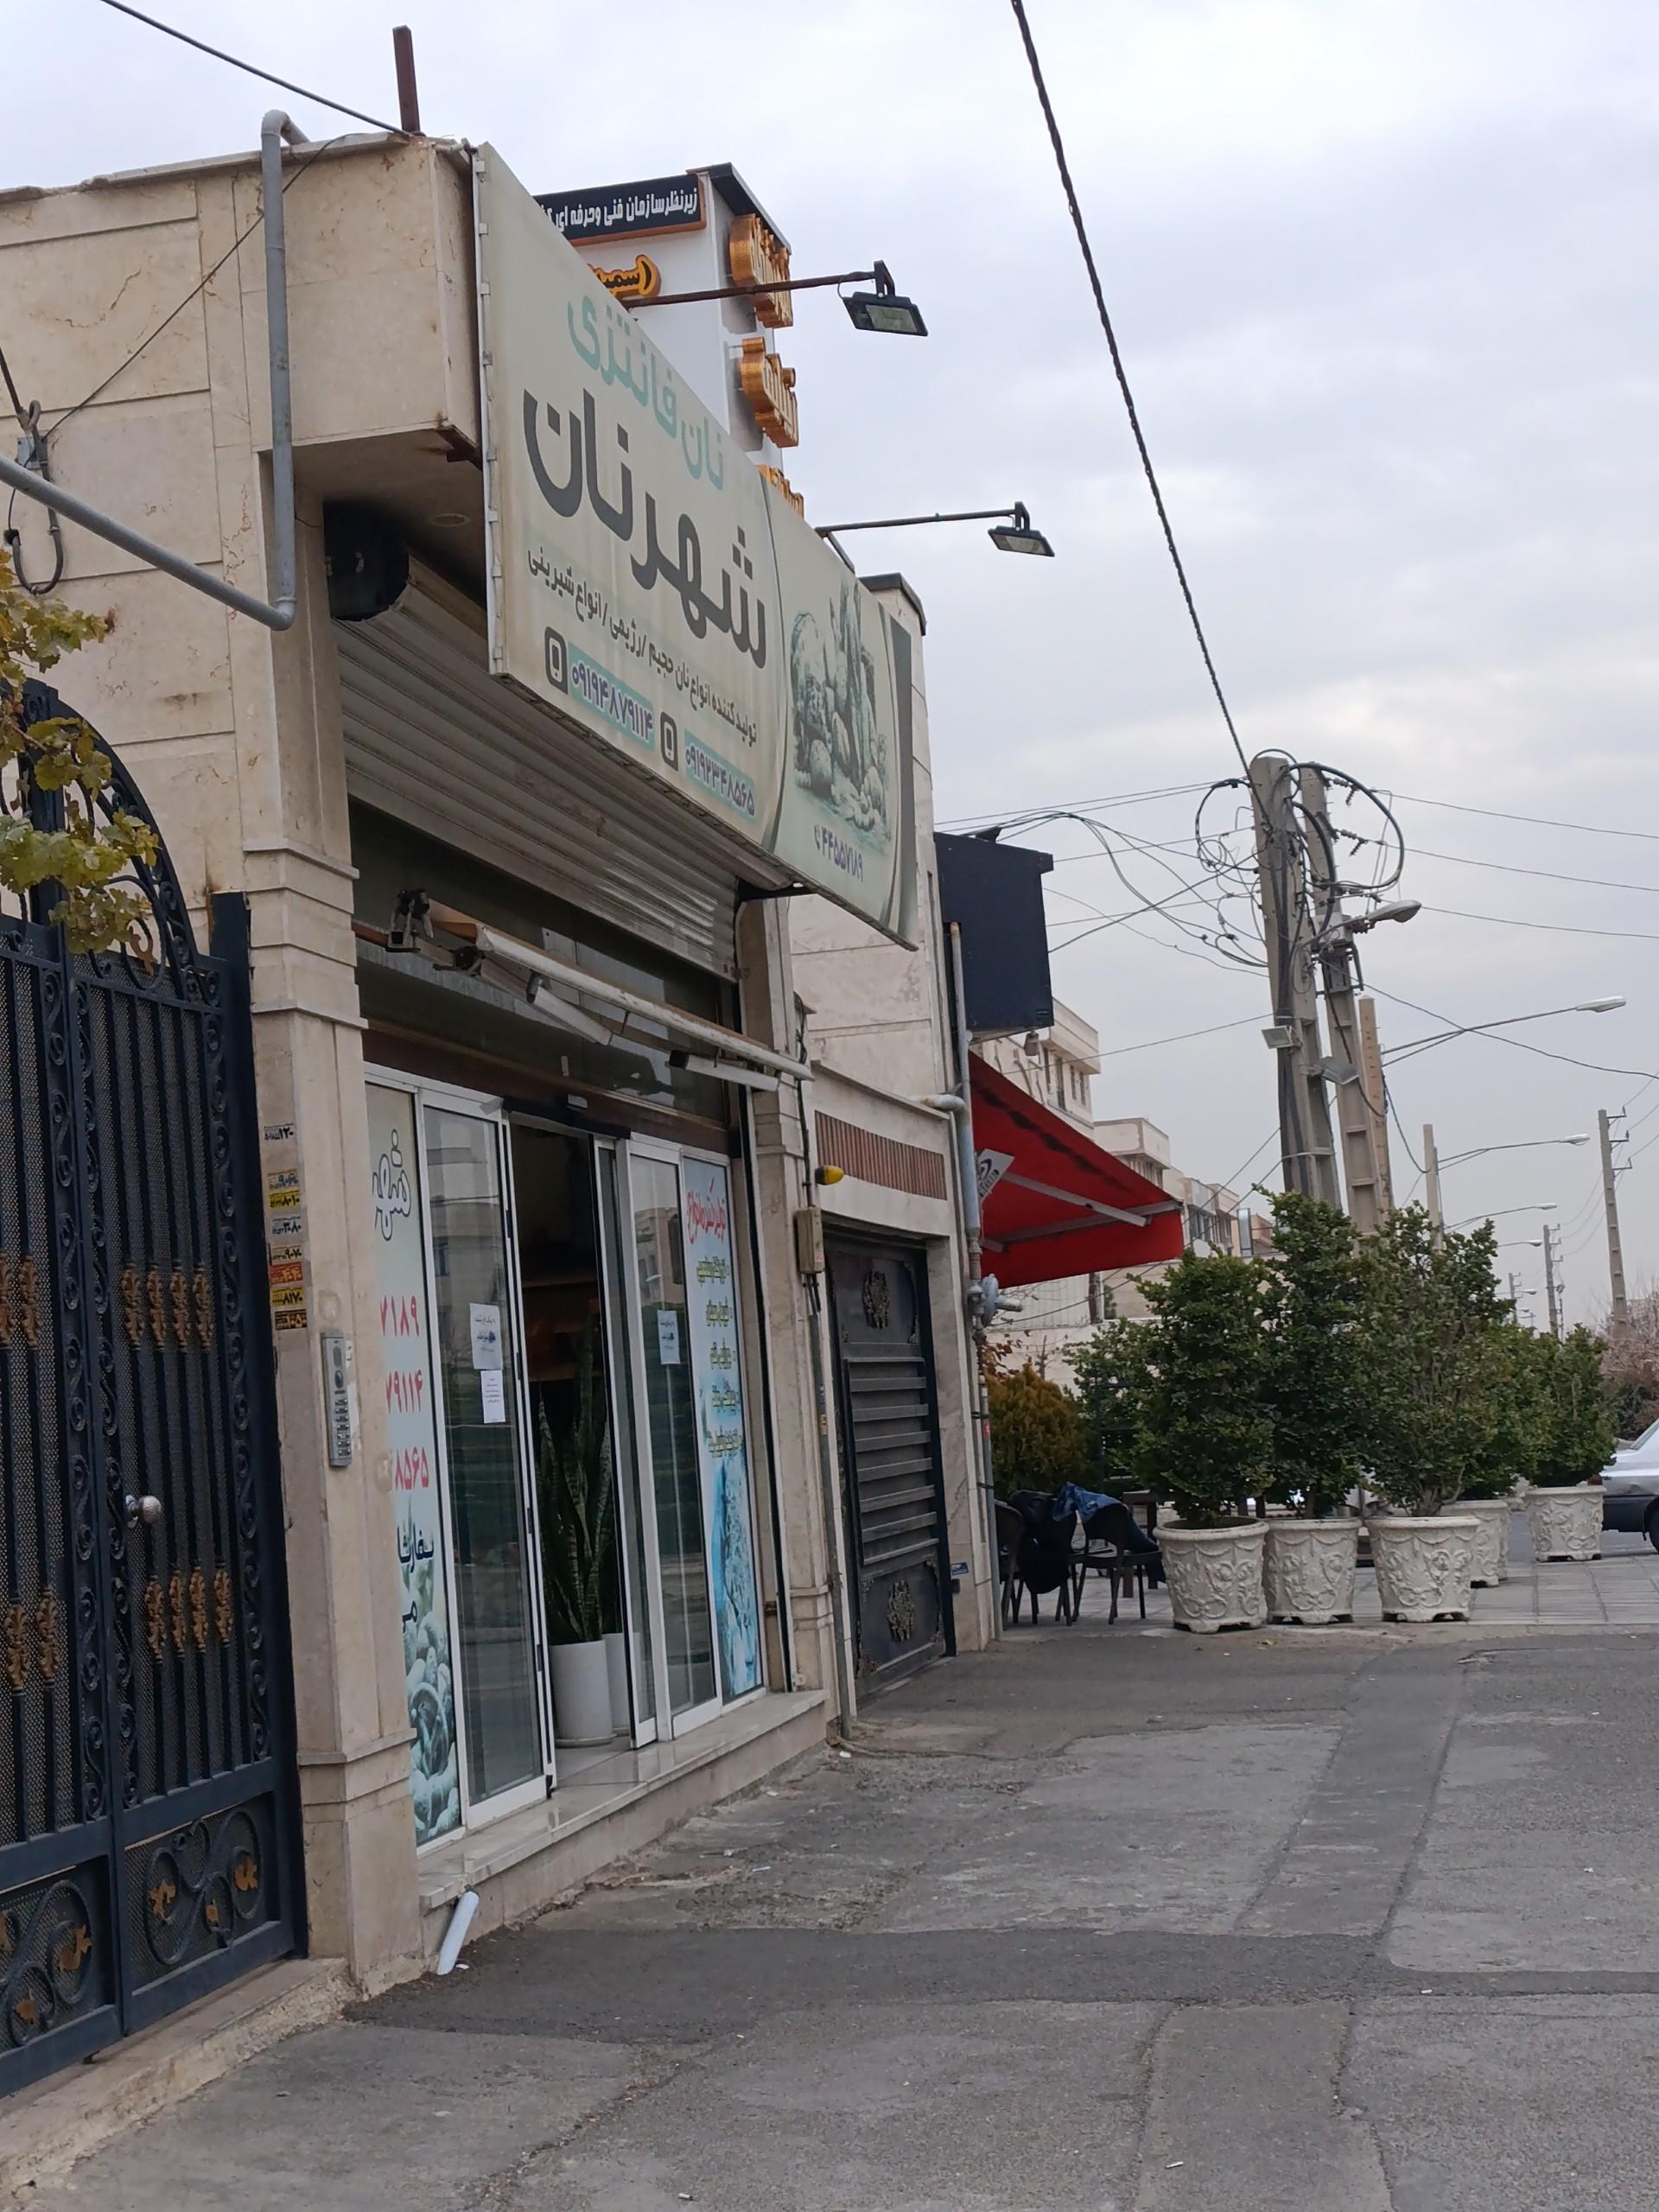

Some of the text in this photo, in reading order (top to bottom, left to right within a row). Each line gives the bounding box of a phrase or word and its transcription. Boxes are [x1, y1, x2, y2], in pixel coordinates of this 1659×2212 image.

[603, 198, 624, 227] فنی
[567, 295, 724, 491] نان فانتزی
[523, 388, 633, 542] نان
[528, 546, 575, 598] شیرینی
[631, 492, 766, 670] شهر
[575, 581, 602, 623] انواع
[649, 642, 674, 678] حجیم
[675, 661, 690, 691] نان
[572, 662, 654, 741] ۰۹۱۹۴۸۷۹۱۱۴
[690, 675, 711, 711] انواع
[711, 693, 735, 727] کننده
[735, 713, 757, 748] تولید
[394, 1446, 429, 1491] ۸۵۶۵
